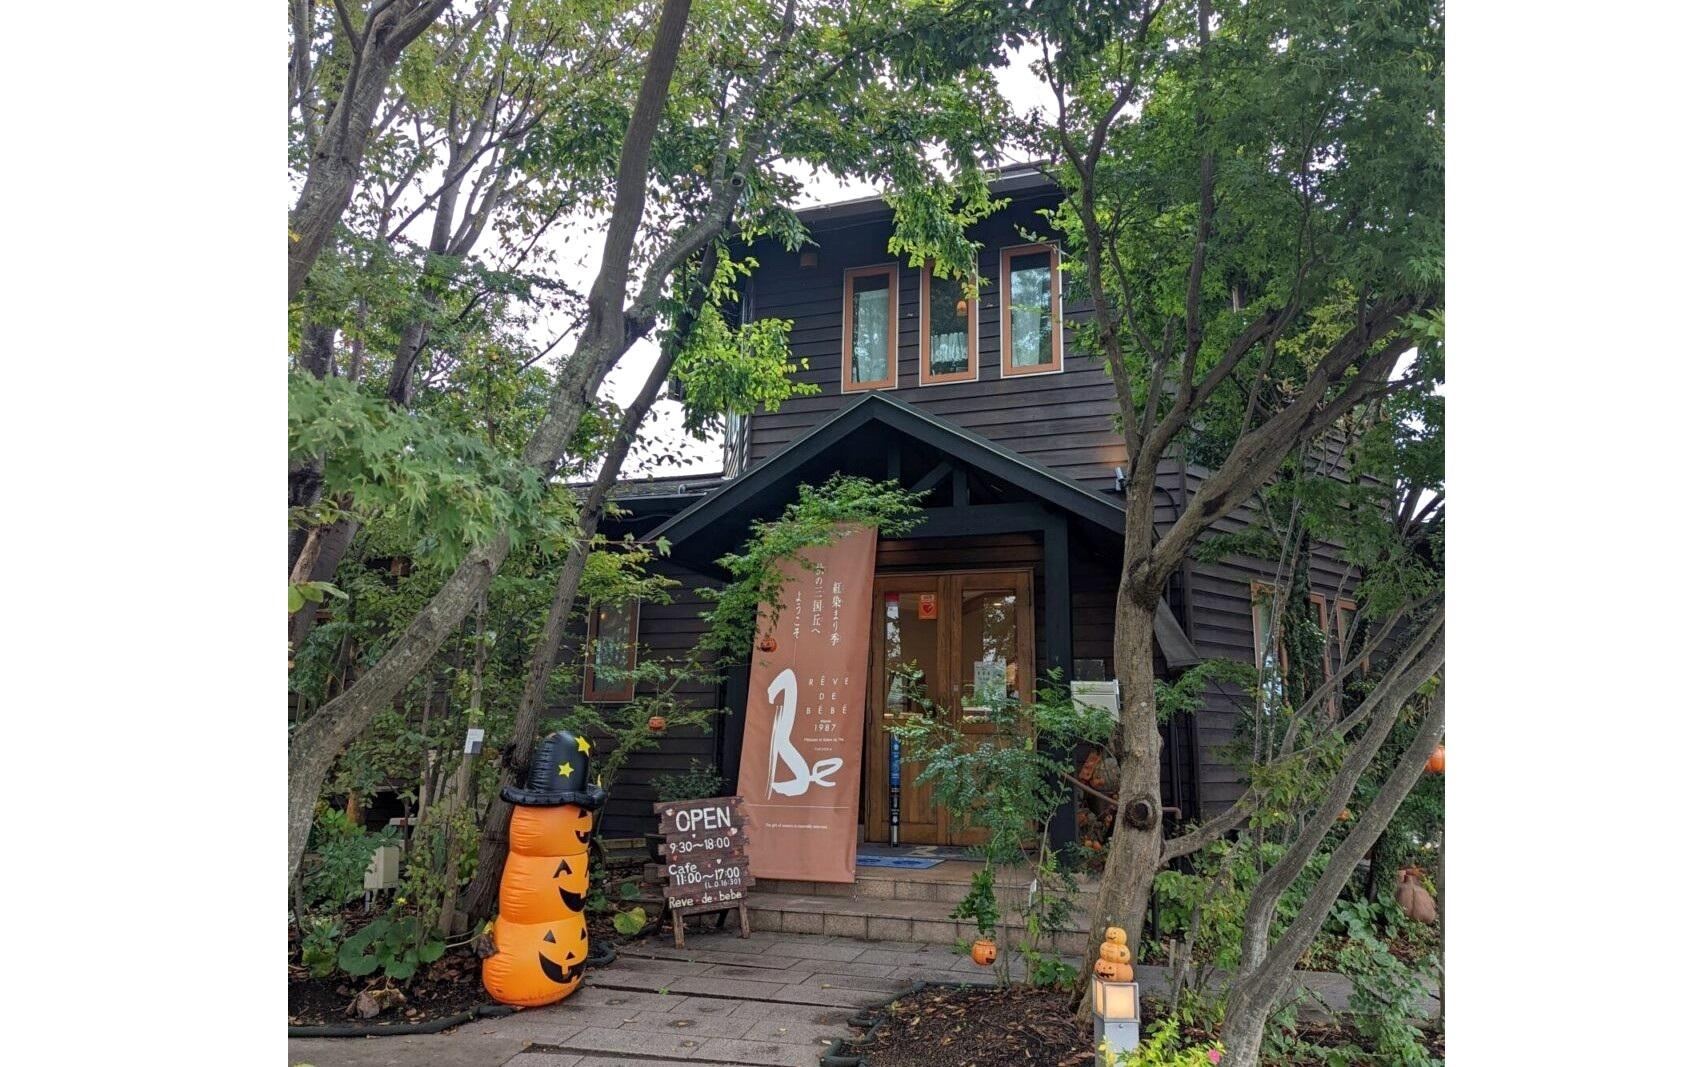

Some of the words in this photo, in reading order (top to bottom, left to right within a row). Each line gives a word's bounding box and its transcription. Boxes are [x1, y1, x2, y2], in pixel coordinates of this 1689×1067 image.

[792, 591, 801, 640] ようこそ
[819, 692, 838, 700] DE
[814, 723, 836, 732] 1987
[675, 806, 732, 832] OPEN
[668, 862, 698, 875] Cafe
[668, 896, 694, 909] Reve
[701, 892, 713, 904] de
[719, 889, 742, 902] bebe
